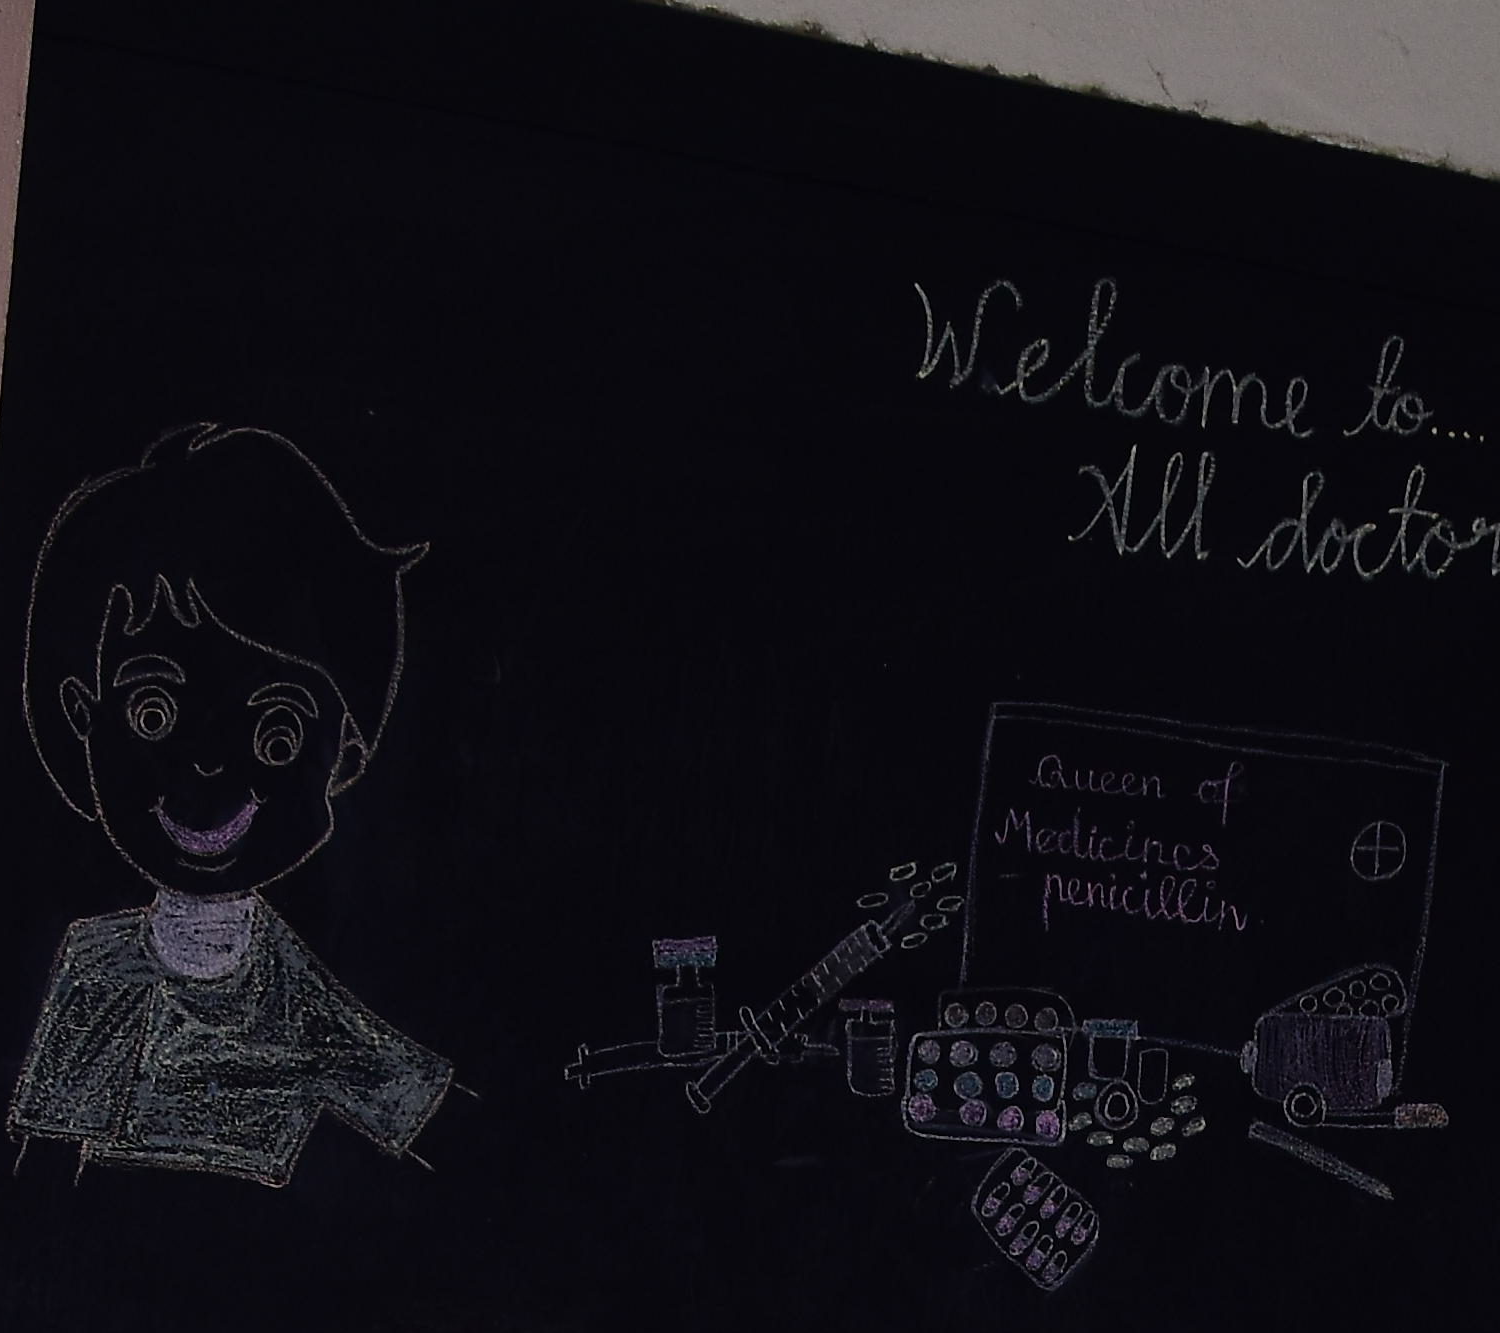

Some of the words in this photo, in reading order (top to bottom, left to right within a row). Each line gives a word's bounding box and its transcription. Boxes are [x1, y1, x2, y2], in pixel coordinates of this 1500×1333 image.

[914, 279, 1313, 438] Welcome
[1068, 444, 1216, 560] All
[1029, 755, 1163, 799] Queen
[1195, 761, 1244, 826] of
[995, 807, 1220, 871] Medicines
